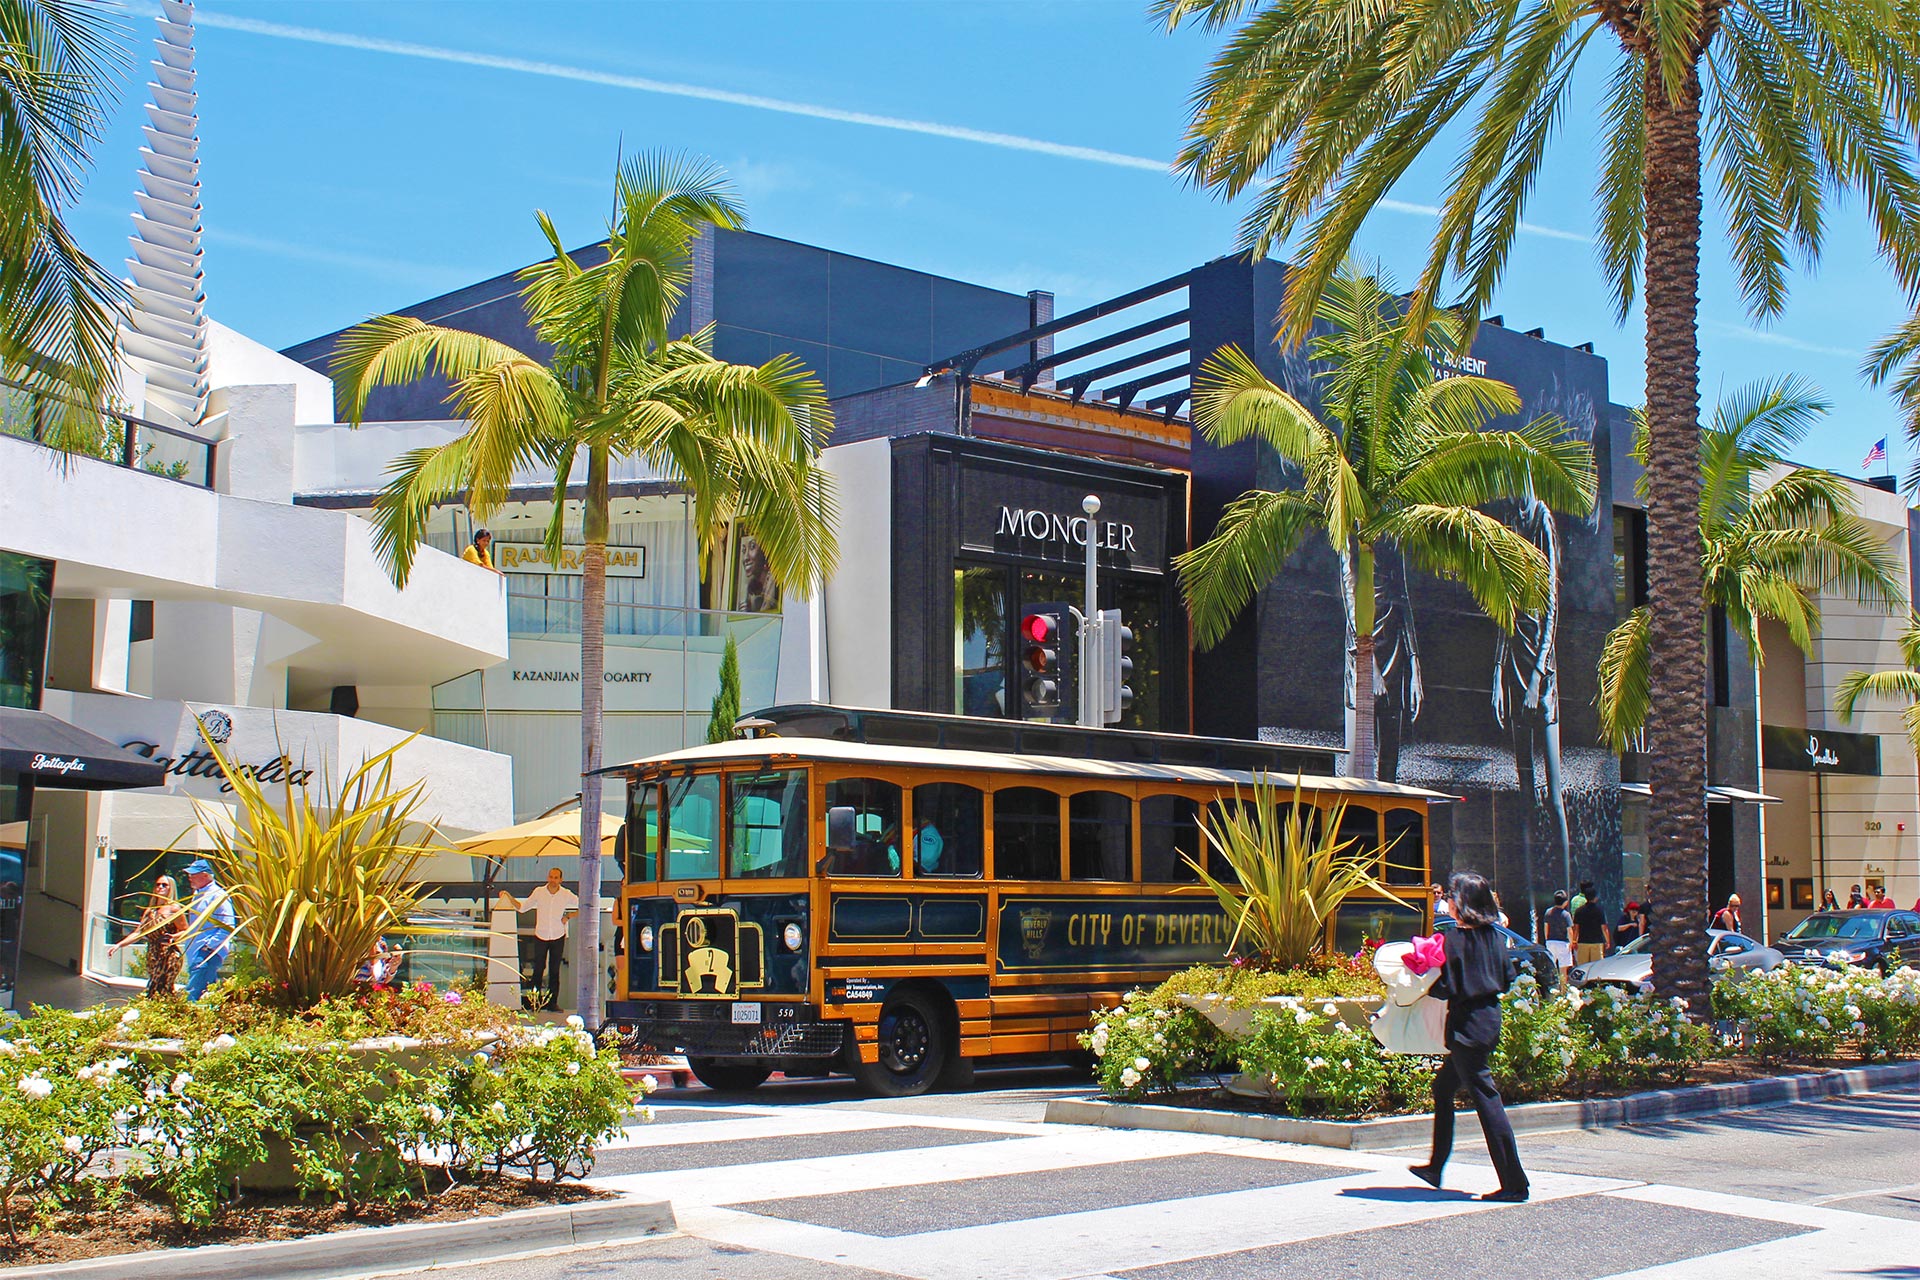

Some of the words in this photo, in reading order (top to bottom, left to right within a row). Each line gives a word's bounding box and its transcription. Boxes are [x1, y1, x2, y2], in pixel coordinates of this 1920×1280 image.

[996, 506, 1137, 552] MONCER
[513, 671, 579, 681] KAZANJIAN
[603, 672, 652, 682] OGARTY
[31, 753, 87, 775] Battaglia
[1864, 821, 1882, 831] 320
[1023, 919, 1047, 929] BEVERLY
[1026, 929, 1043, 939] HILLS
[1068, 913, 1112, 946] CITY
[1121, 913, 1147, 946] OF
[1155, 913, 1232, 945] BEVERLY
[777, 1008, 795, 1018] 550
